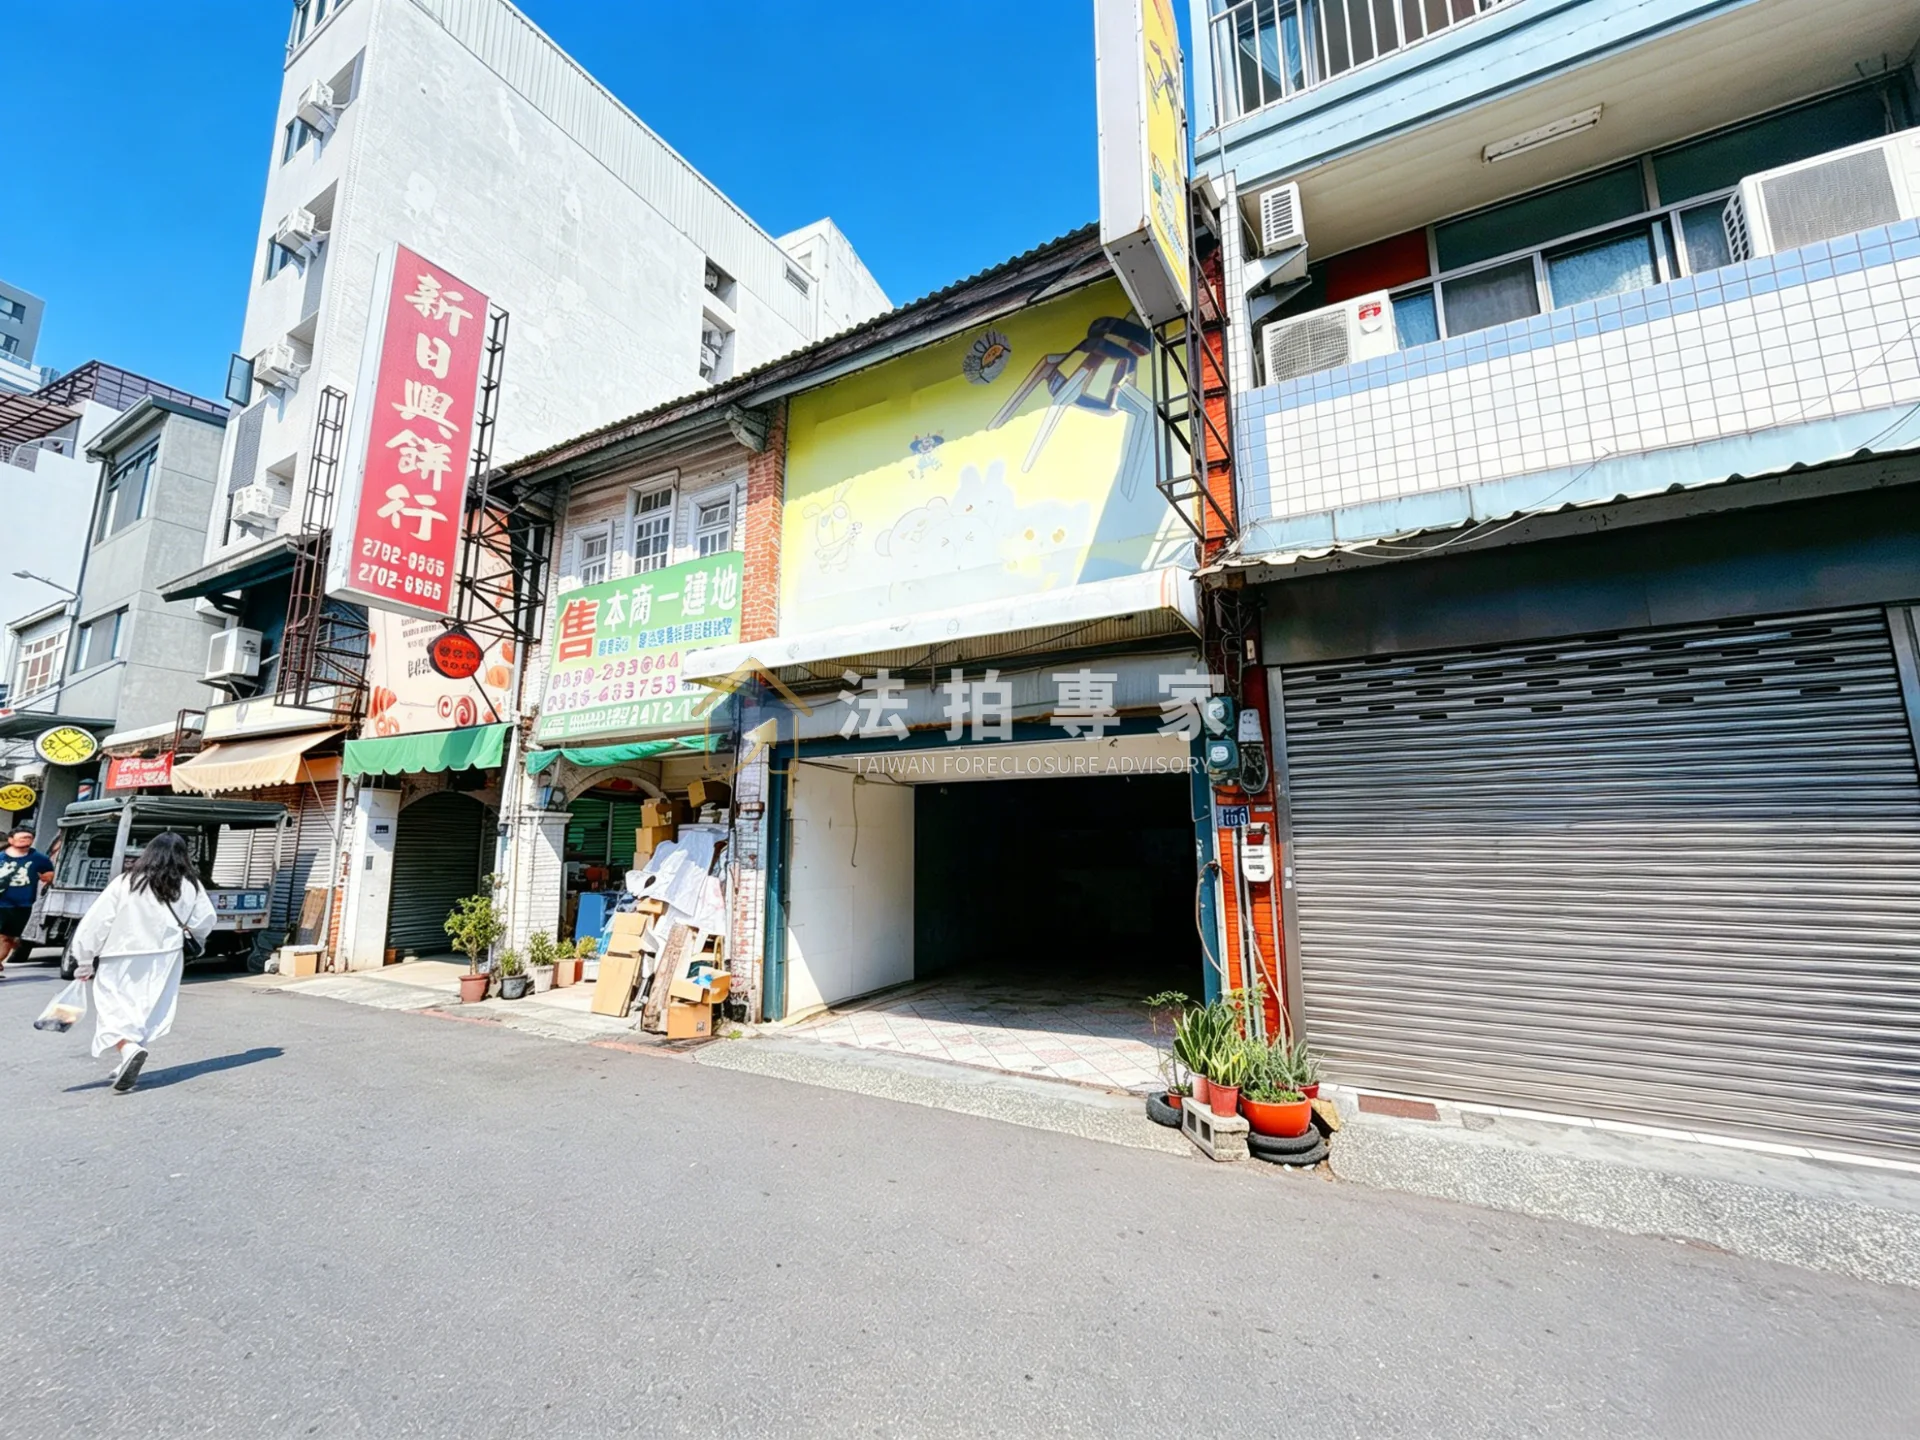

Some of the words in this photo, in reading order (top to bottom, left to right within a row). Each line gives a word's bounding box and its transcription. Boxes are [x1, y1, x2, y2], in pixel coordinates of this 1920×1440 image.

[376, 272, 474, 542] 新日興餅行
[559, 598, 600, 663] 售
